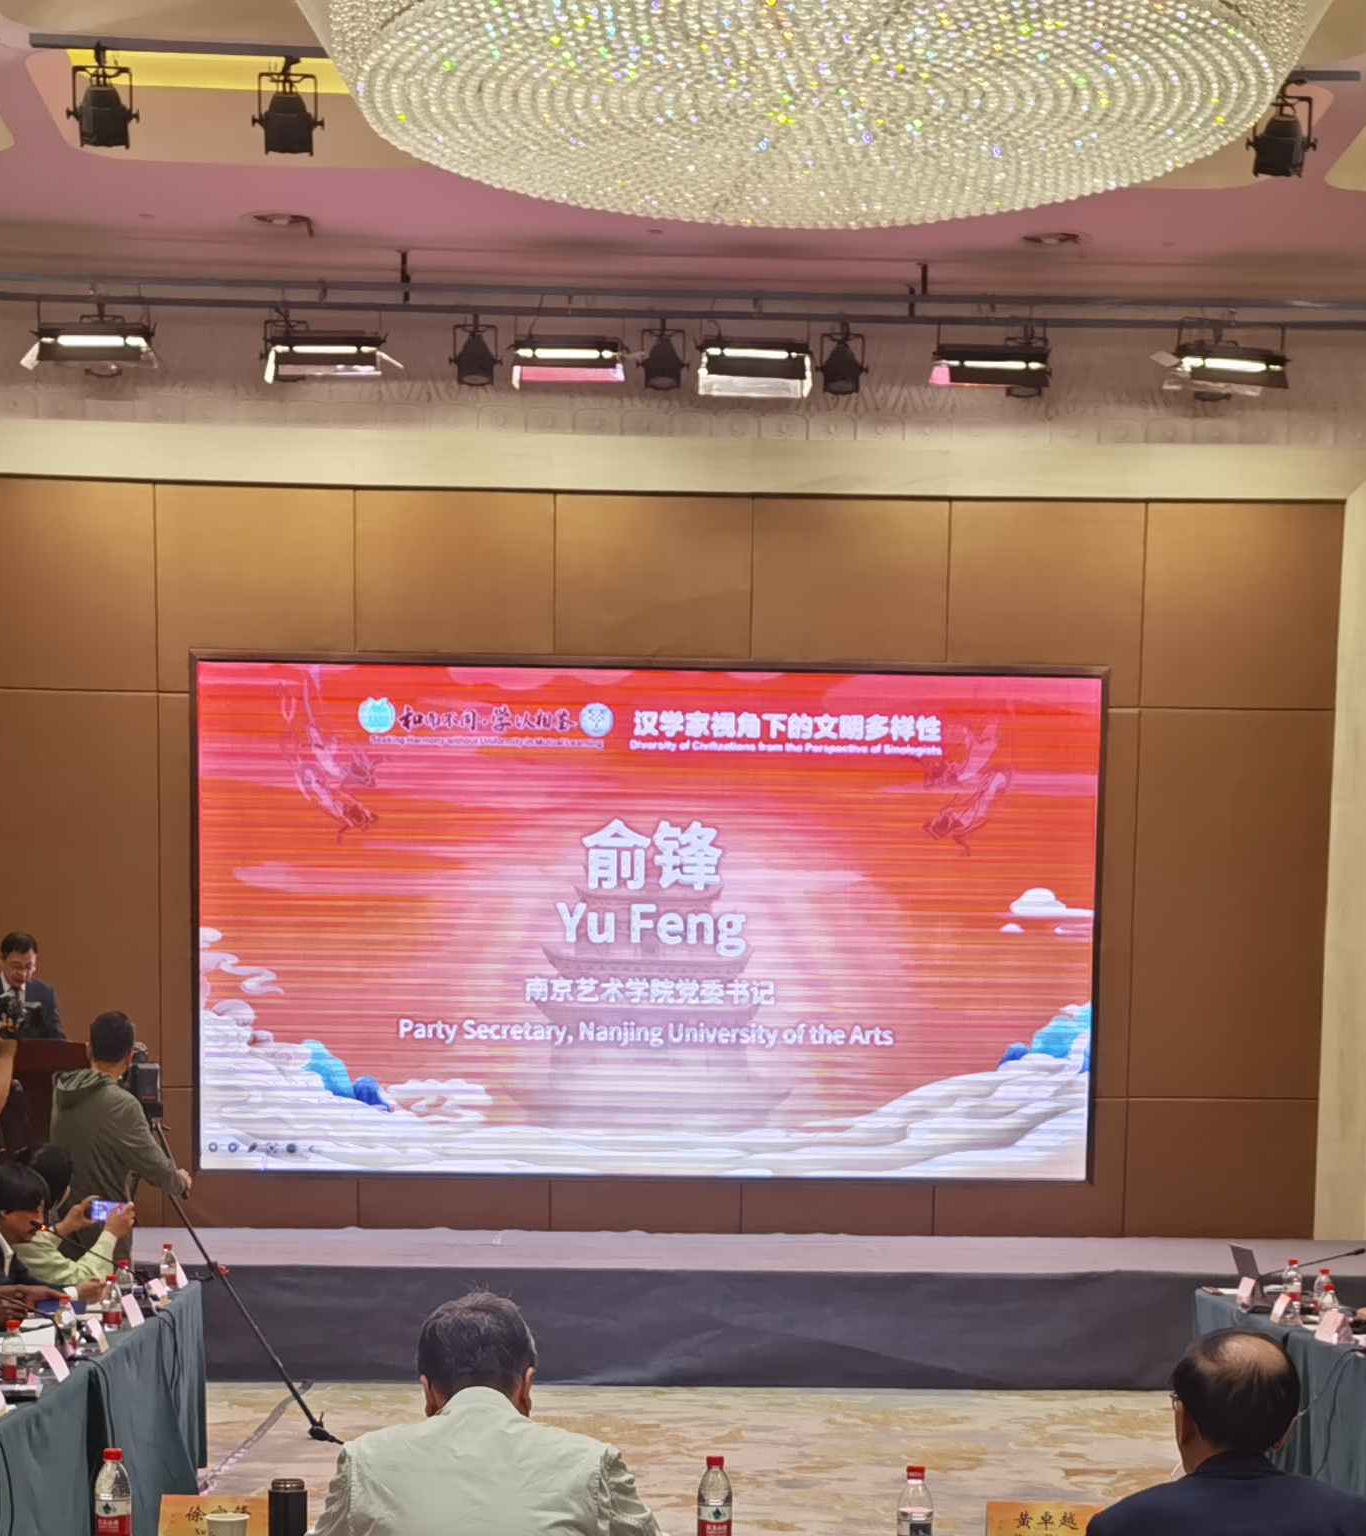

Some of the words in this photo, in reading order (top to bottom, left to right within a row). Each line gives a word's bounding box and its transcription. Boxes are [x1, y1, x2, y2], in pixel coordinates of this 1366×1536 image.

[633, 710, 942, 742] 汉学家视角下的文明多样性
[407, 736, 444, 747] Harmony
[447, 736, 478, 746] without
[480, 737, 523, 748] Uniformity
[535, 738, 563, 747] Mutual
[565, 738, 602, 750] Learning
[630, 739, 676, 752] Diversity
[679, 740, 690, 751] of
[692, 740, 756, 752] Civilizations
[758, 741, 783, 752] from
[785, 742, 803, 752] the
[804, 742, 868, 755] Perspective
[870, 743, 882, 754] of
[581, 817, 724, 891] 俞锋
[556, 902, 616, 944] Yu
[630, 903, 747, 957] Feng
[524, 976, 775, 1006] 南京艺术学院党委书记
[398, 1018, 458, 1046] Party
[462, 1020, 574, 1046] Secretary,
[579, 1021, 664, 1048] Nanjing
[667, 1022, 777, 1048] University
[782, 1022, 810, 1045] of
[809, 1023, 846, 1046] the
[848, 1024, 895, 1046] Arts
[1014, 1510, 1080, 1531] 黄卓越
